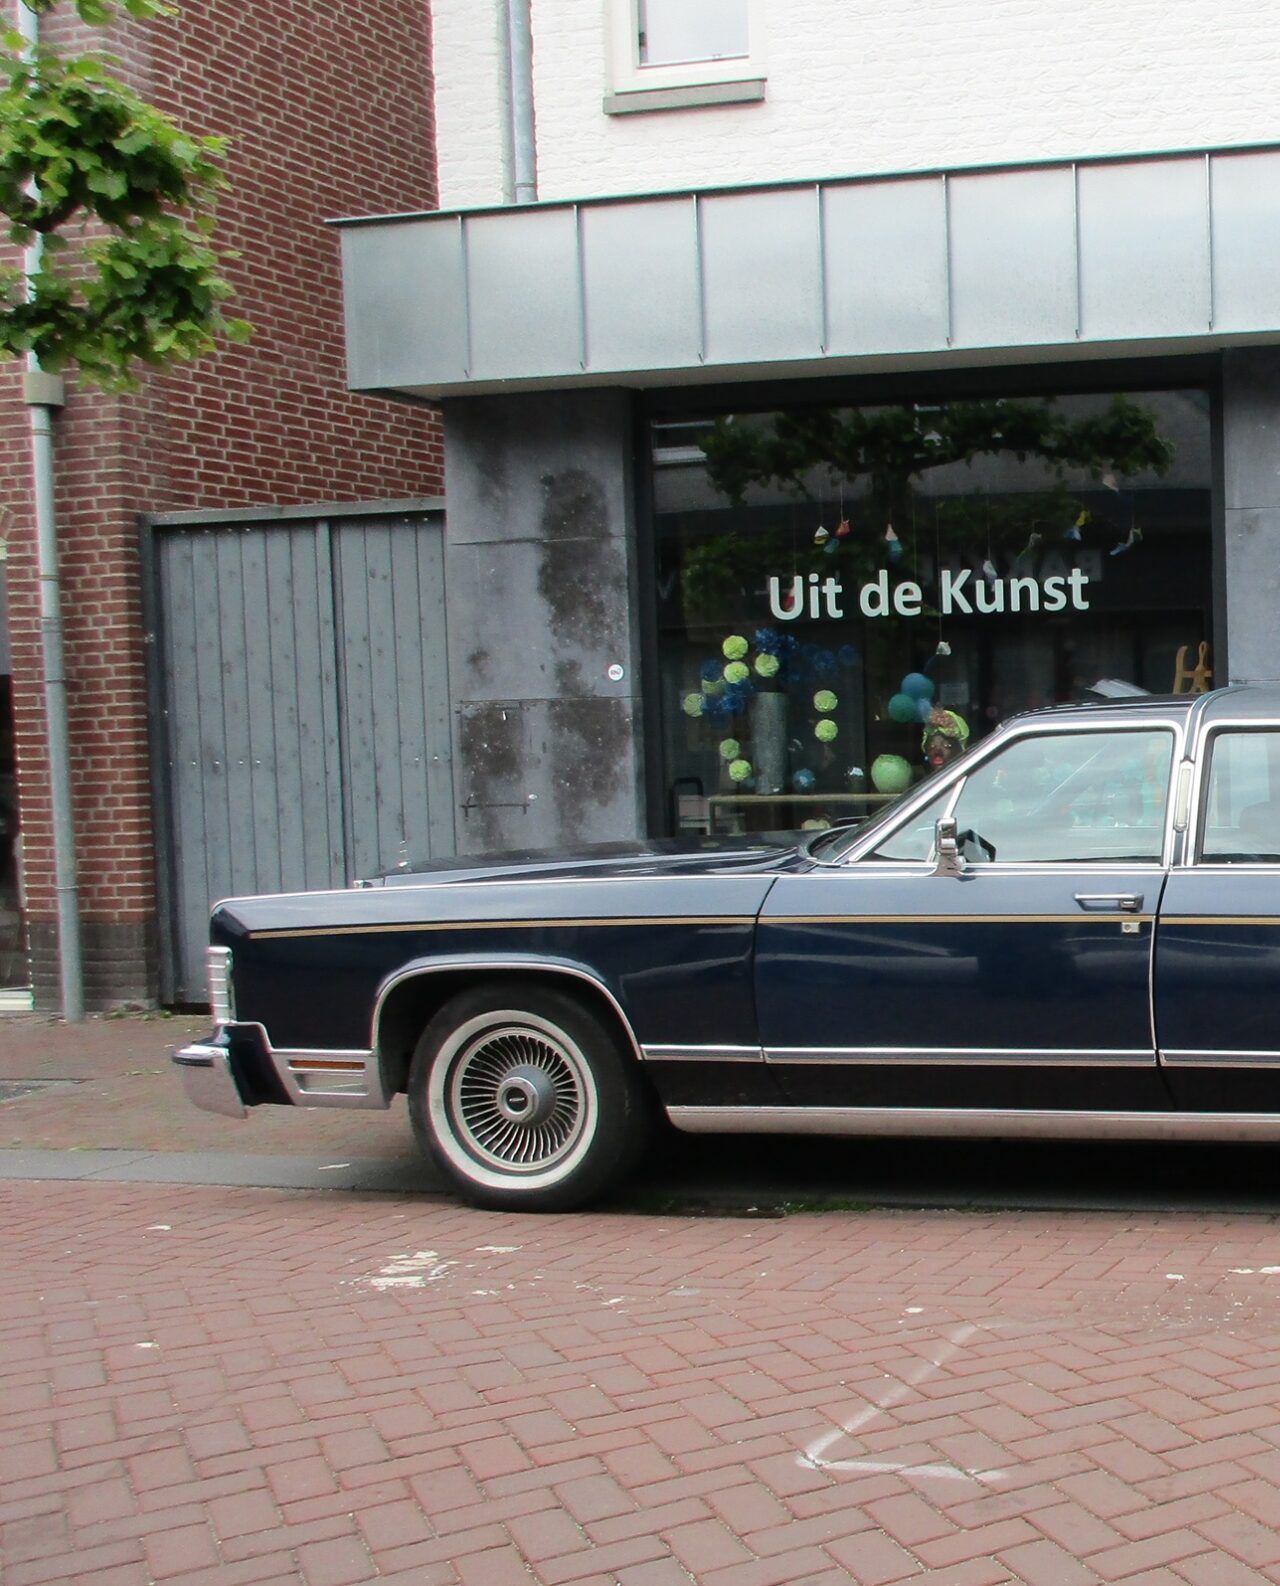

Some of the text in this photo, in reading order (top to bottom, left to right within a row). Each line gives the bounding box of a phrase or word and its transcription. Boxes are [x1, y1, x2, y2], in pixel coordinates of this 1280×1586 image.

[769, 568, 1090, 621] Uit de Kunst
